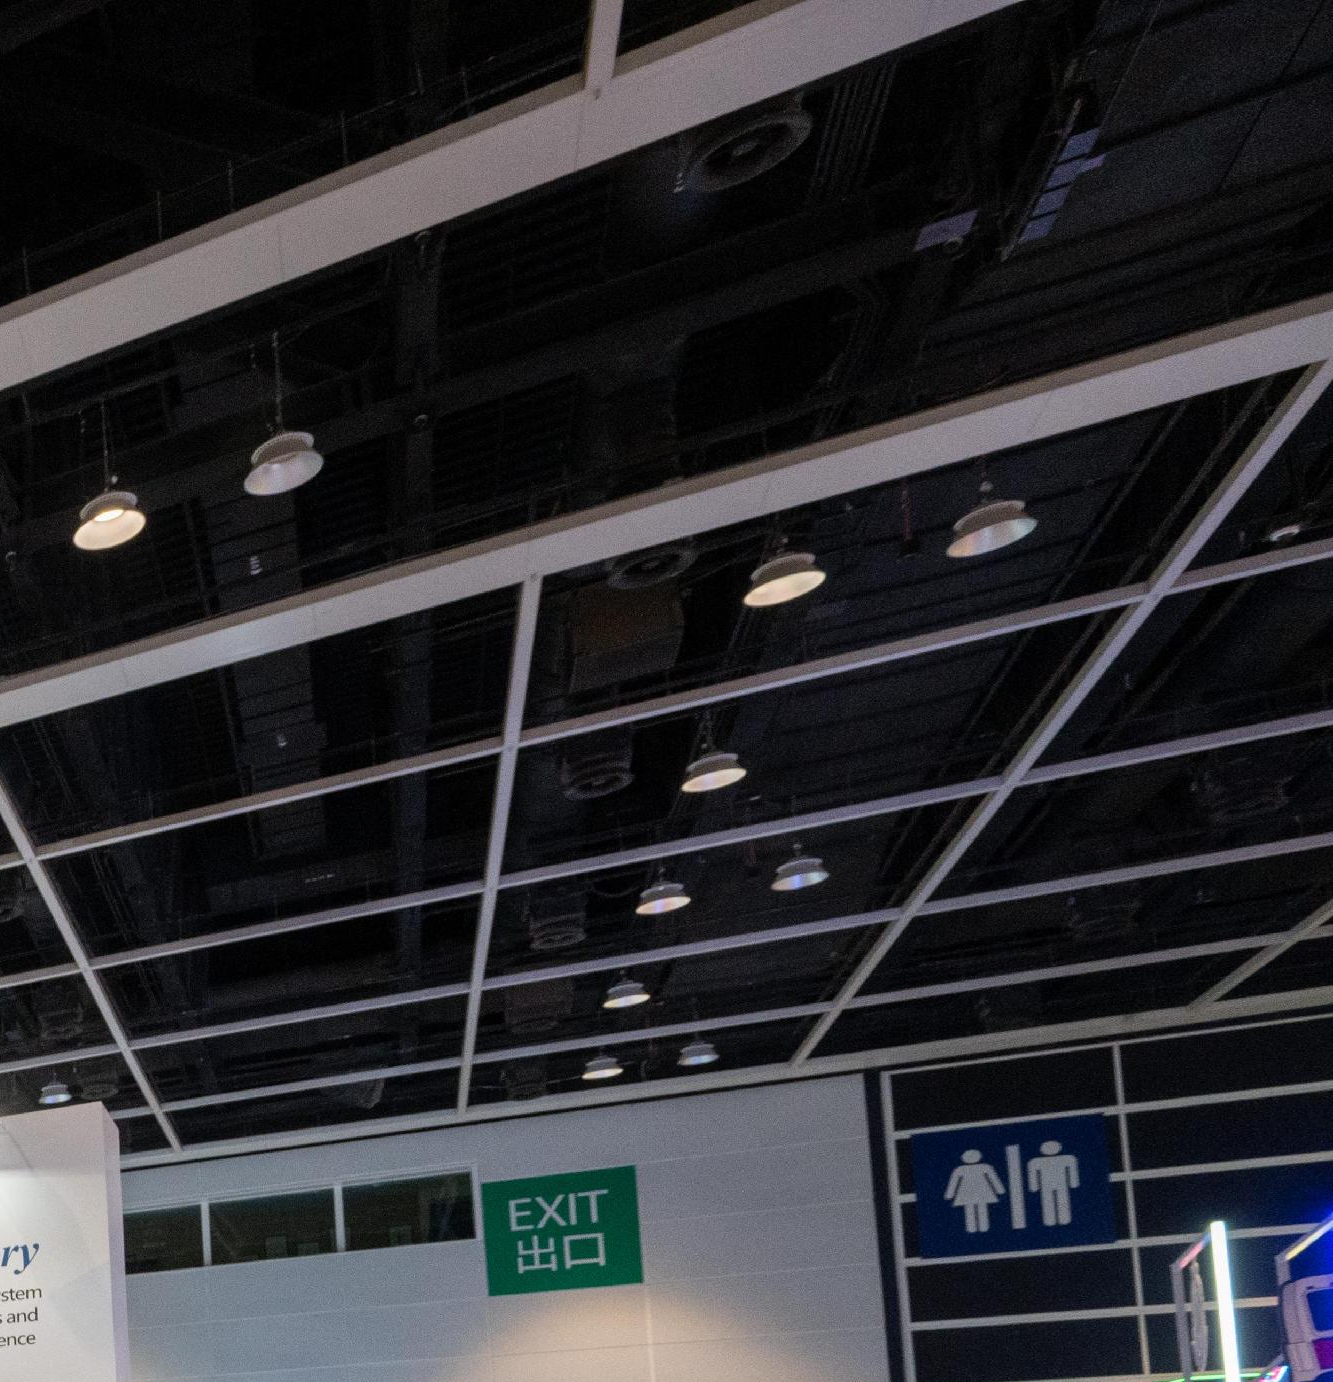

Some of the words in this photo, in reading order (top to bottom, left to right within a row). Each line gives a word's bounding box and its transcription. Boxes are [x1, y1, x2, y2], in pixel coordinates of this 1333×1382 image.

[508, 1189, 609, 1232] EXIT
[517, 1233, 606, 1274] 出口
[6, 1307, 39, 1325] and
